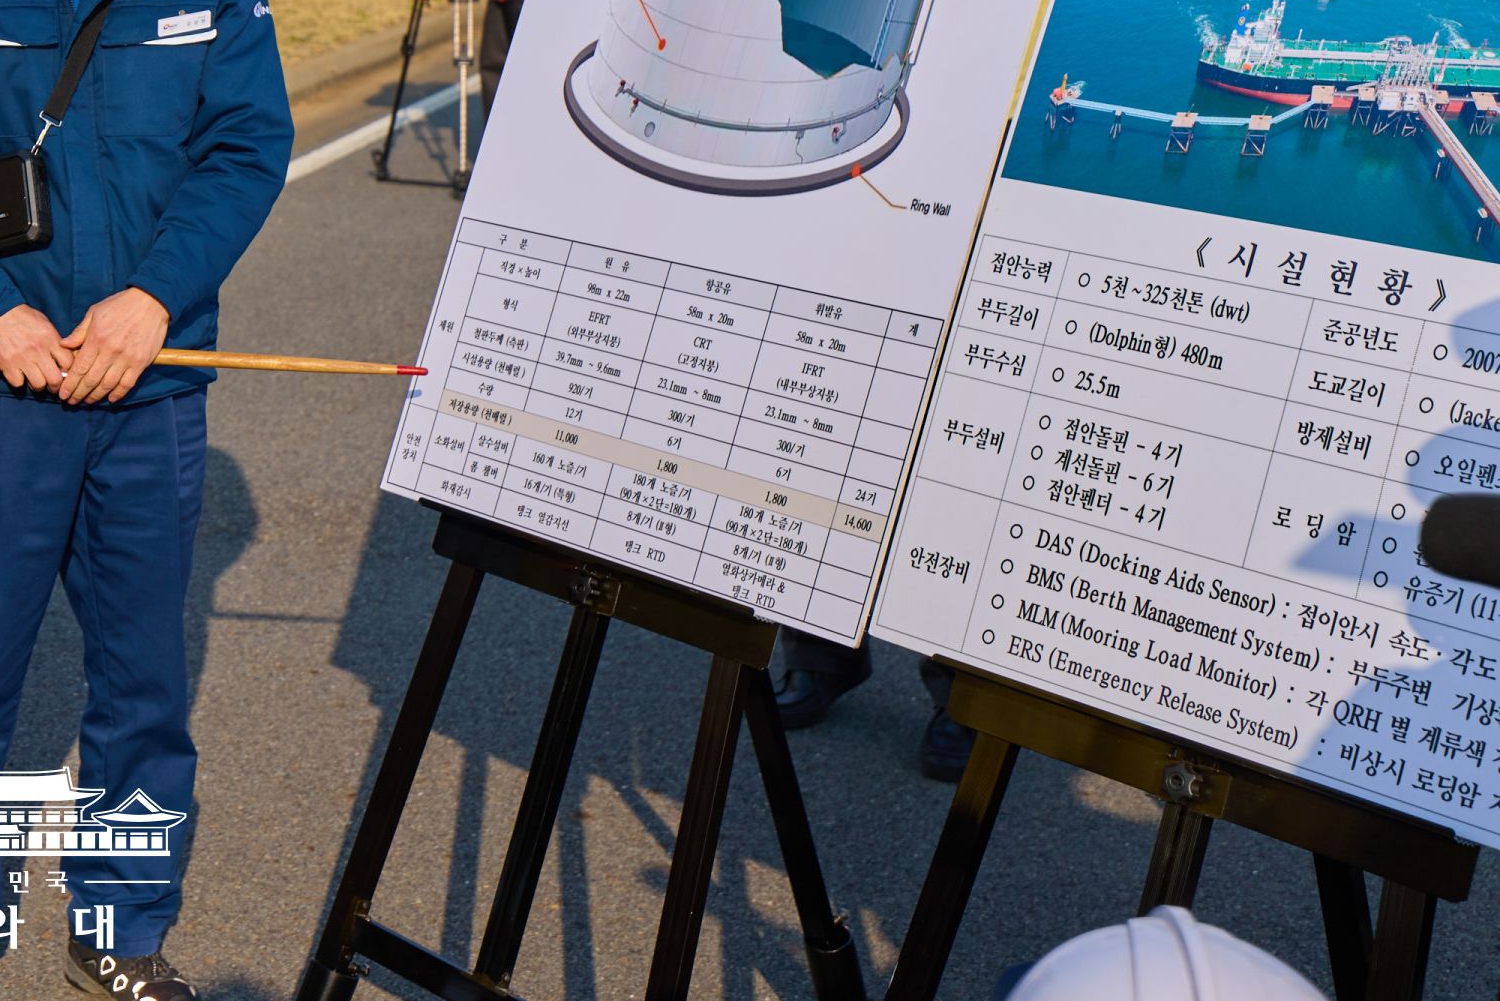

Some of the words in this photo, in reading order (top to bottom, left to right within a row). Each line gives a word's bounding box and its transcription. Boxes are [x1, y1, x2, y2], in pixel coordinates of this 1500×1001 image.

[910, 198, 930, 215] Ring
[933, 202, 951, 216] Wall
[991, 252, 1052, 284] 접안능력
[587, 283, 602, 296] 98m
[615, 289, 631, 302] 22m
[706, 279, 732, 295] 항공유
[503, 297, 518, 311] 형식
[815, 303, 843, 320] 휘발유
[977, 298, 1040, 330] 부두길이
[1210, 295, 1250, 324] (dwt)
[588, 311, 612, 326] EFRT
[687, 305, 703, 320] 58m
[717, 312, 734, 327] 20m
[908, 323, 919, 337] 계
[1323, 318, 1400, 352] 준공년도
[693, 336, 713, 350] CRT
[796, 331, 813, 345] 58m
[828, 338, 846, 352] 20m
[555, 351, 584, 368] 39.7mm
[597, 361, 621, 377] 9.6mm
[801, 362, 825, 378] IFRT
[964, 343, 1026, 377] 부두수심
[568, 382, 593, 399] 920/기
[657, 377, 688, 396] 23.1mm
[702, 389, 722, 404] 8mm
[776, 377, 839, 404] (내부부상지붕)
[1074, 370, 1121, 398] 25.5m
[1308, 370, 1386, 408] 도교길이
[565, 407, 582, 422] 12기
[668, 410, 695, 427] 300/기
[765, 405, 797, 424] 23.1mm
[812, 418, 833, 434] 8mm
[555, 429, 578, 445] 11,000
[667, 436, 681, 450] 6기
[944, 419, 1006, 454] 부두설비
[1064, 418, 1130, 454] 접안돌핀
[1298, 422, 1372, 460] 방제설비
[776, 439, 806, 458] 300/기
[657, 459, 678, 475] 1,800
[775, 467, 791, 481] 6기
[1054, 449, 1121, 485] 계선돌핀
[1433, 455, 1500, 489] 오일펜
[765, 491, 788, 507] 1,800
[855, 489, 876, 506] 24기
[1047, 480, 1112, 516] 접안펜더
[844, 514, 872, 532] 14,600
[646, 547, 666, 563] RTD
[910, 546, 970, 584] 안전장비
[1036, 528, 1074, 556] DAS
[1080, 539, 1162, 585] (Docking
[1164, 567, 1205, 596] Aids
[1209, 578, 1276, 618] Sensor)
[1298, 603, 1380, 649] 접이안시
[1404, 576, 1464, 614] 유증기
[755, 593, 776, 609] RTD
[1026, 564, 1066, 592] BMS
[1070, 576, 1127, 612] (Berth
[1131, 596, 1238, 646] Management
[1241, 629, 1320, 672] System)
[1348, 660, 1432, 707] 부두주변
[1452, 693, 1500, 726] 기상
[1016, 599, 1060, 630] MLM
[1061, 612, 1140, 658] (Mooring
[1144, 639, 1192, 672] Load
[1196, 656, 1277, 700] Monitor)
[1332, 699, 1383, 734] QRH
[1418, 726, 1486, 768] 계류색
[1008, 634, 1044, 663] ERS
[1048, 646, 1154, 702] (Emergency
[1157, 684, 1222, 724] Release
[1227, 707, 1299, 751] System)
[1340, 742, 1407, 786] 비상시
[1412, 768, 1481, 808] 로딩암
